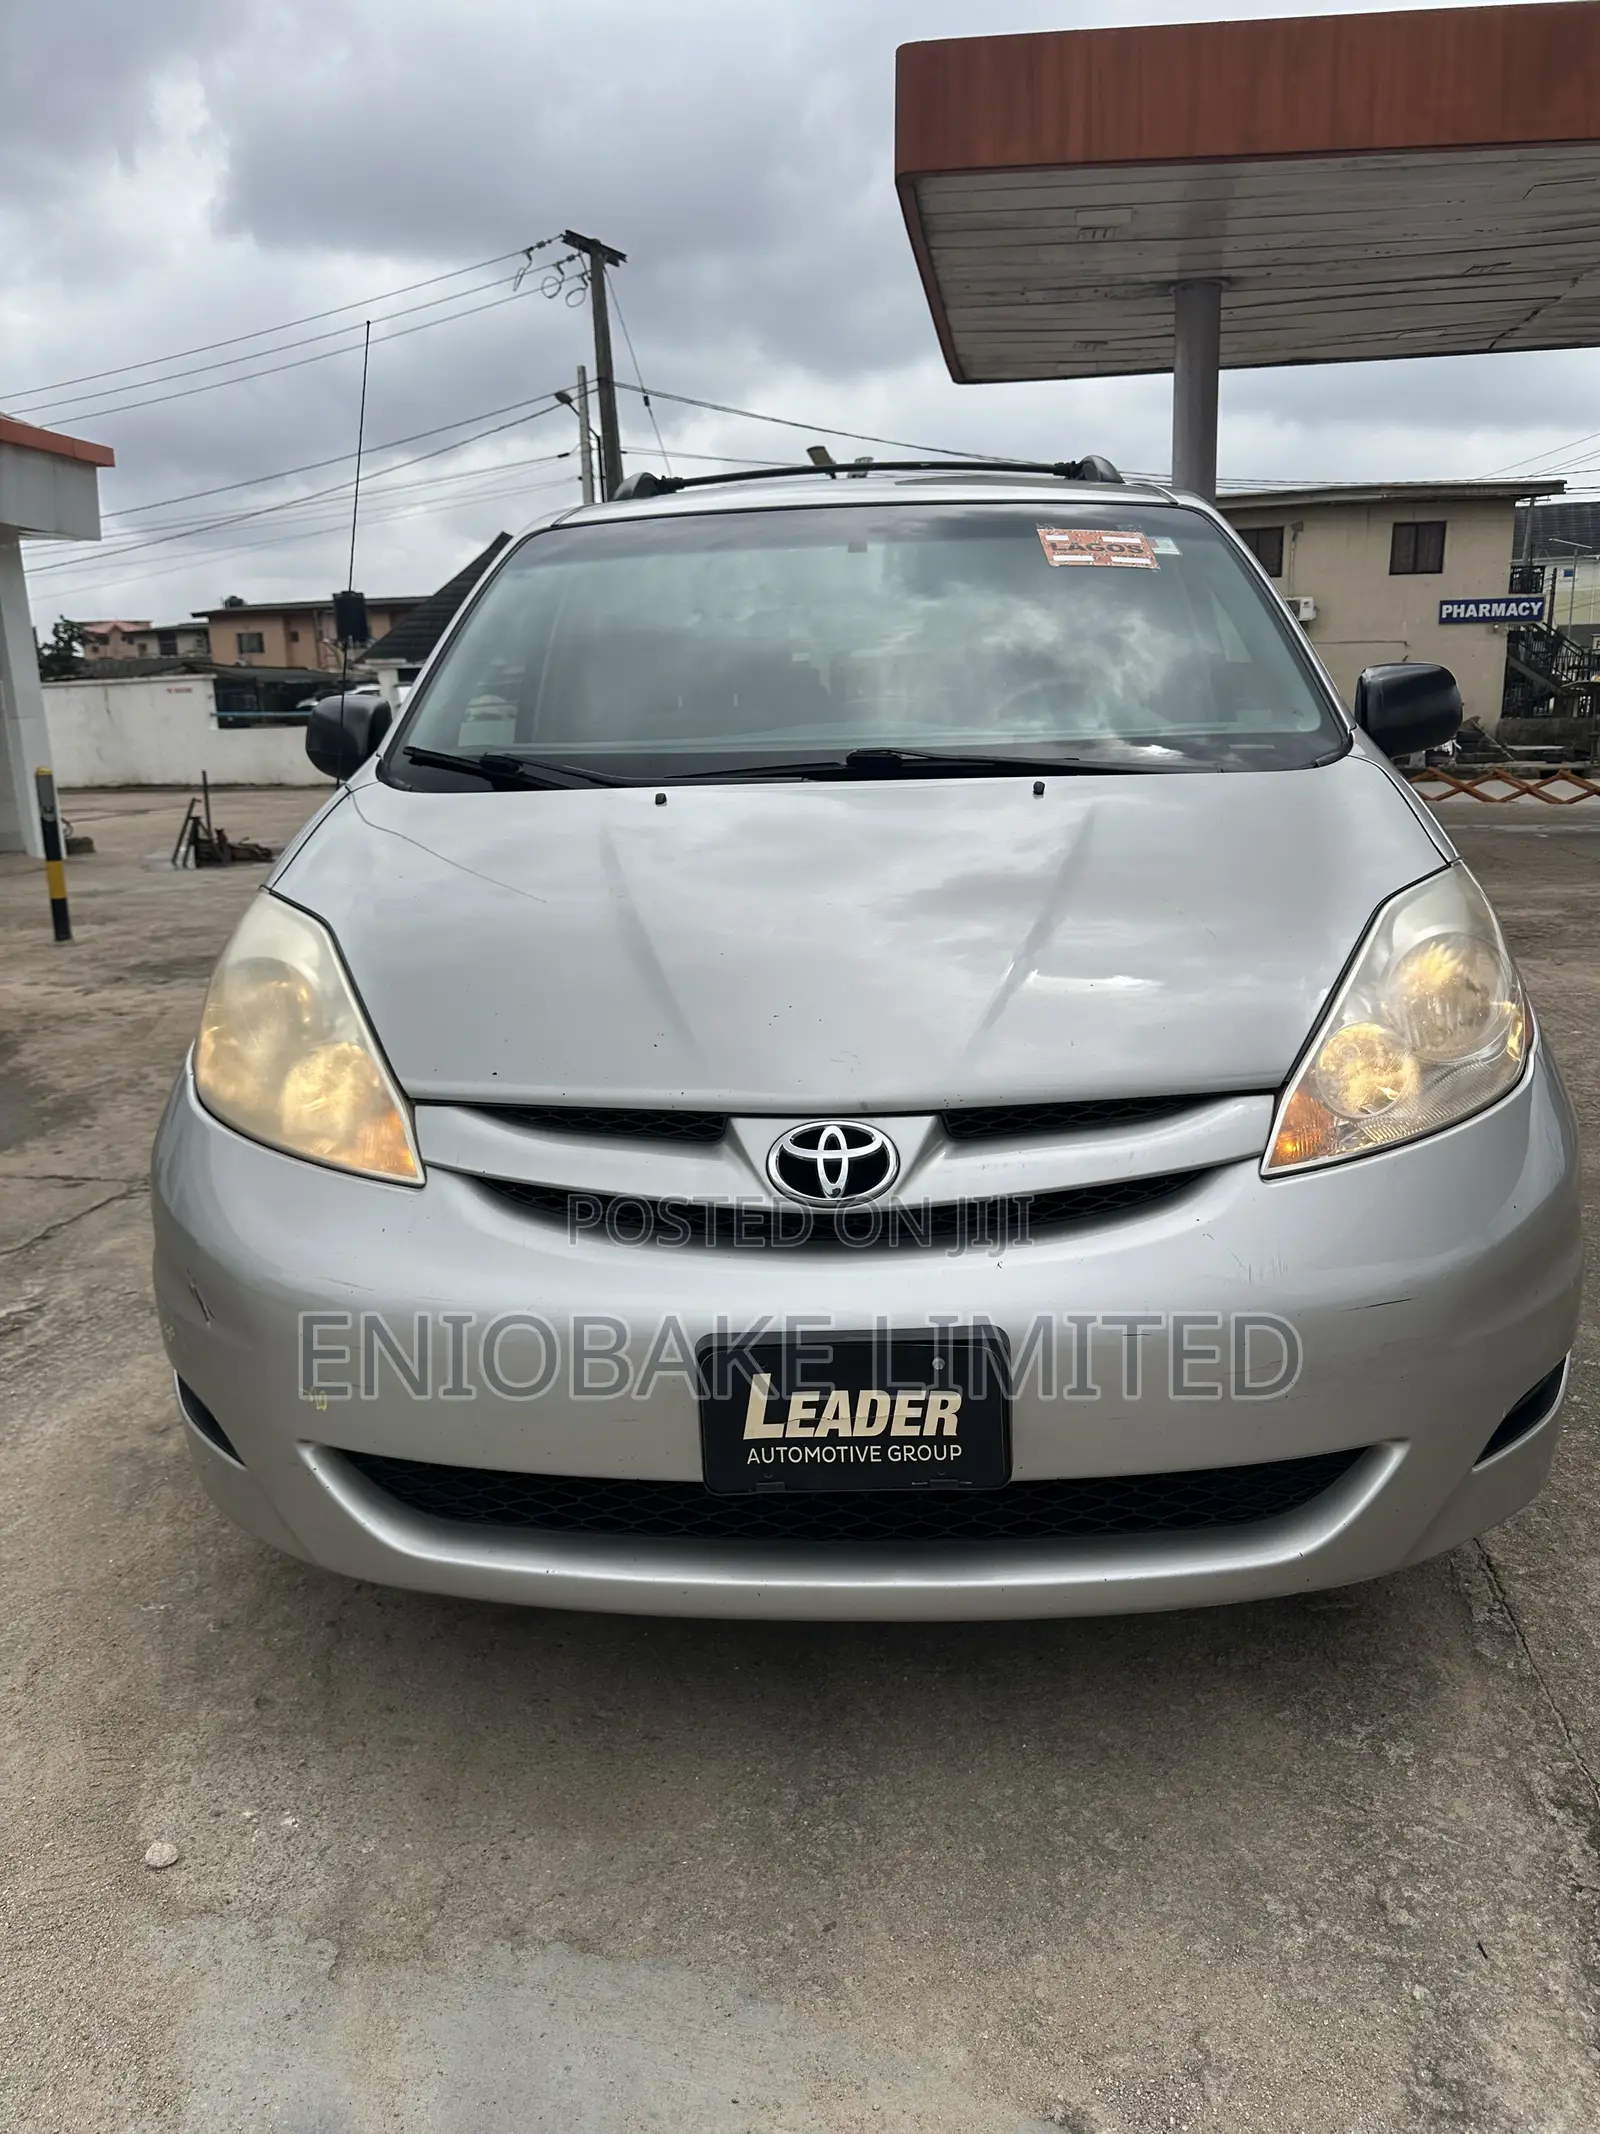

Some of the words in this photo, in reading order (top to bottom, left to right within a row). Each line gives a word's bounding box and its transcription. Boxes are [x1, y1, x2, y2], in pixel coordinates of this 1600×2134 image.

[1049, 541, 1145, 554] LAGOS
[1441, 601, 1543, 619] PHARMACY
[743, 1373, 963, 1440] LEADER
[747, 1446, 883, 1465] AUTOMOTIVE
[887, 1444, 963, 1462] GROUP
